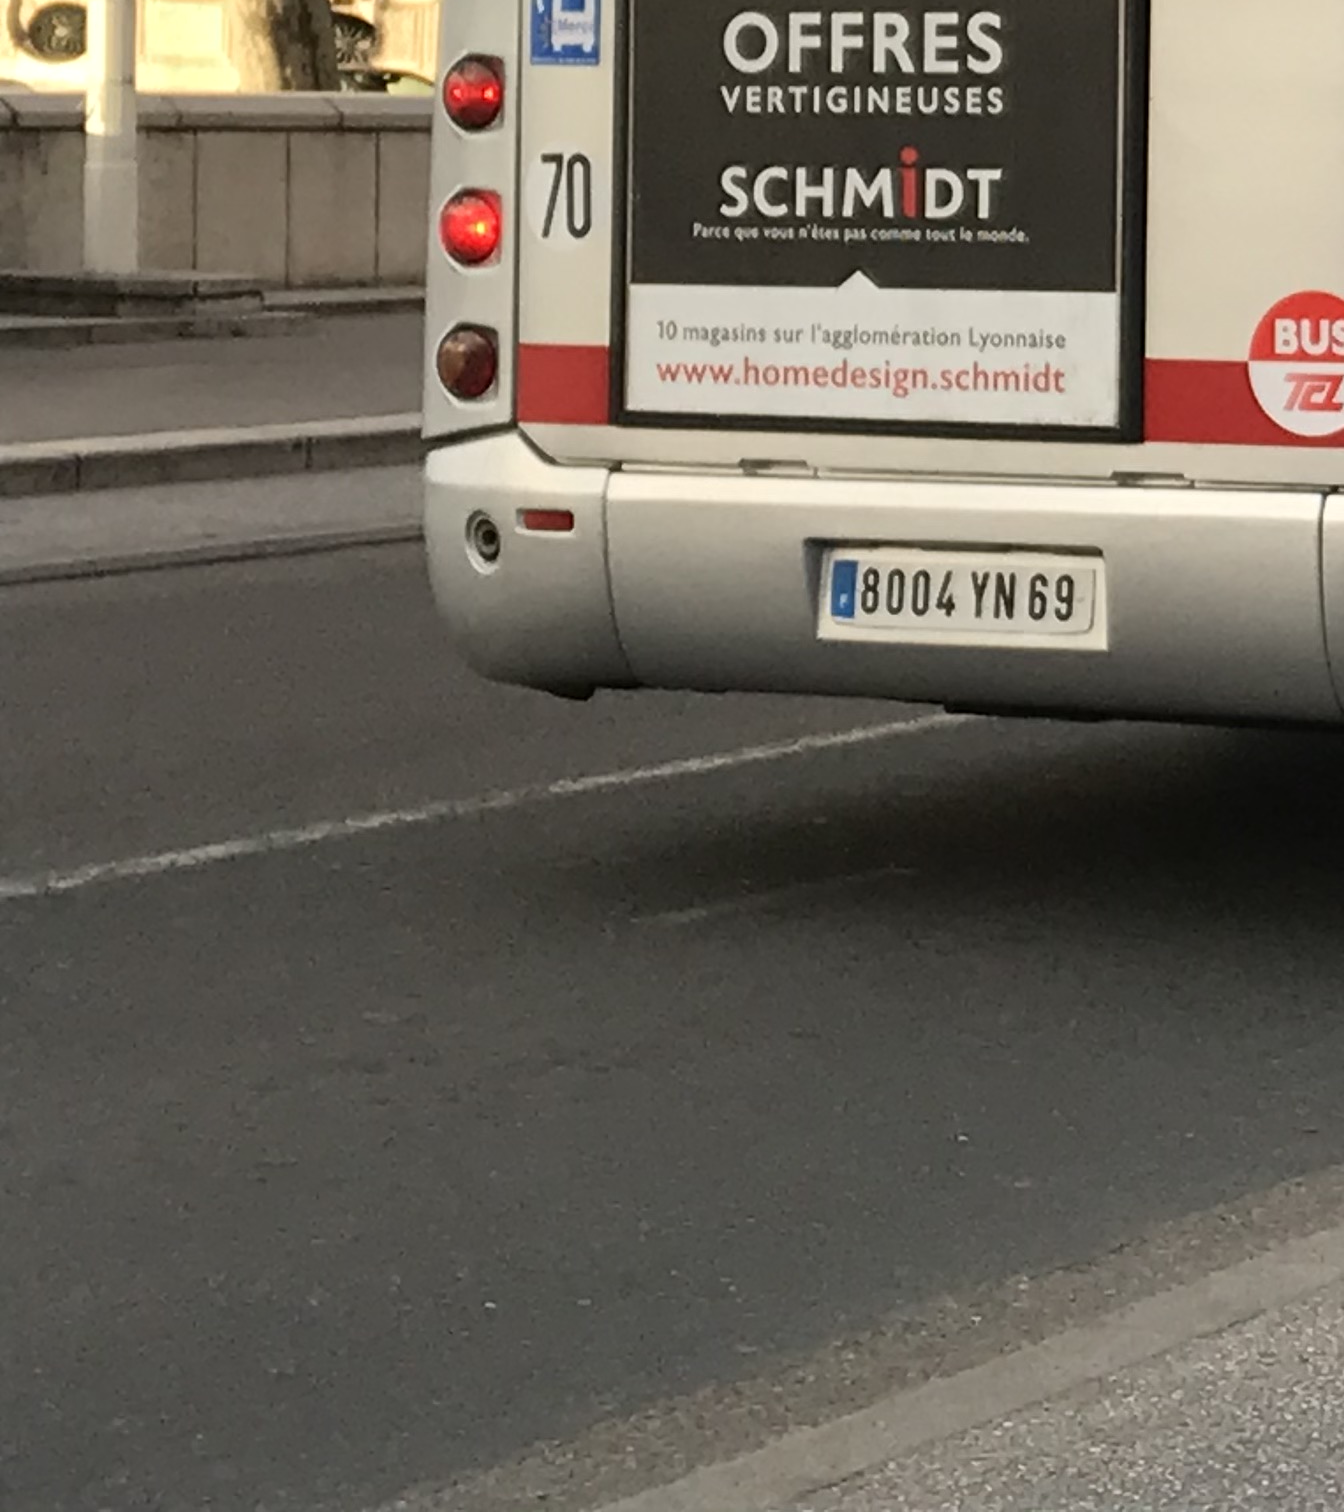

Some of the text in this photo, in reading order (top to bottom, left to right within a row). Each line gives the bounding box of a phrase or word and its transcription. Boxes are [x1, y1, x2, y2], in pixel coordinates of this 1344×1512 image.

[722, 10, 1003, 74] OFFRES
[719, 85, 1004, 115] VERTIGINEUSES
[541, 152, 592, 239] 70
[692, 222, 731, 240] Parce
[734, 226, 760, 242] que
[763, 226, 795, 240] vous
[843, 227, 868, 244] pas
[870, 228, 921, 241] comme
[926, 227, 956, 242] tout
[959, 227, 973, 242] le
[977, 227, 1031, 244] monde.
[656, 320, 1067, 353] 10 magasins sur l'agglomération Lyonnaise
[656, 356, 1067, 398] www.homedesign.schmidt
[860, 567, 957, 618] 8004
[971, 570, 1017, 620] YN
[1027, 573, 1075, 622] 69
